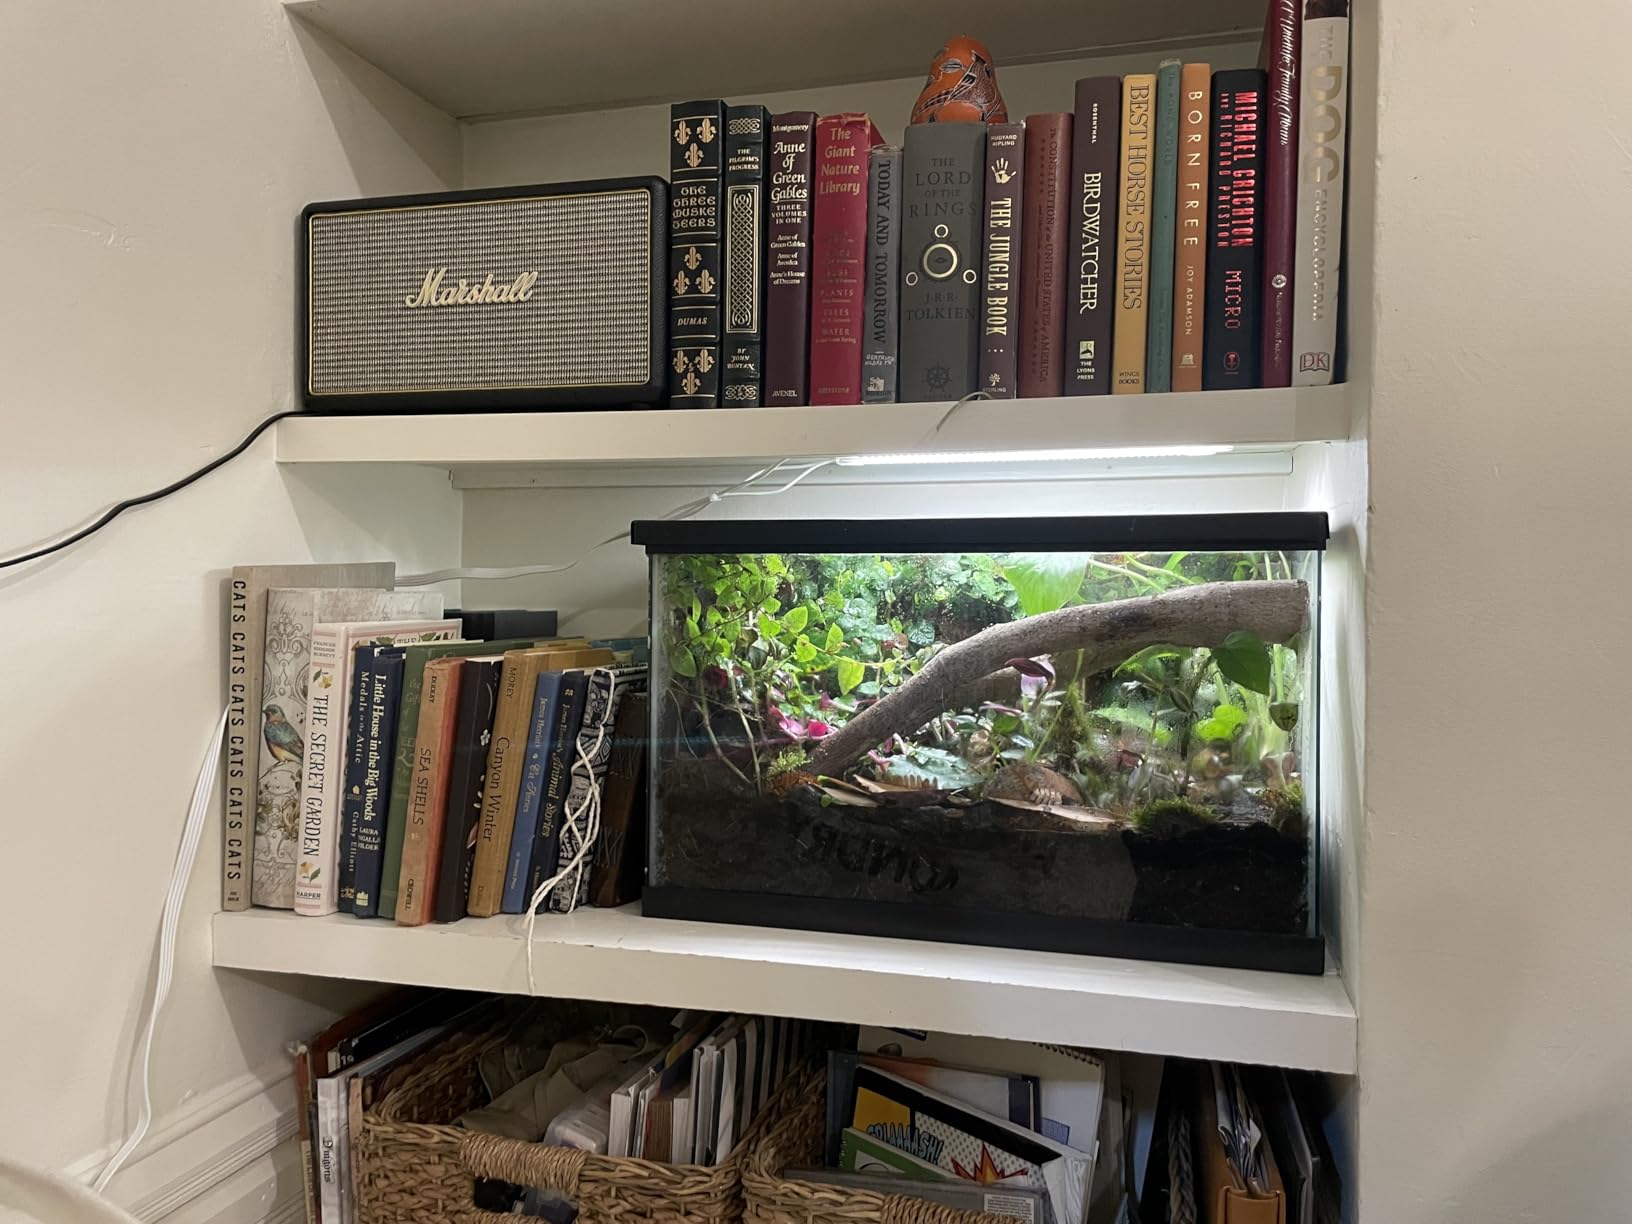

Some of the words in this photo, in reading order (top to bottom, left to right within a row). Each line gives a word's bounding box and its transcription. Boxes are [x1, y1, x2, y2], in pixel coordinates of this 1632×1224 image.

[1279, 15, 1296, 66] Wildlife
[1319, 24, 1334, 63] THE
[1273, 63, 1296, 107] Family
[772, 124, 809, 133] Montgomery
[1128, 85, 1150, 141] BEST
[1187, 91, 1203, 166] BORN
[1233, 91, 1258, 161] MICHAEL
[1277, 105, 1295, 146] Album
[1303, 66, 1343, 184] DOG
[774, 141, 806, 154] Anne
[825, 145, 856, 159] Giant
[830, 128, 851, 140] The
[1218, 114, 1233, 176] RICHARD
[729, 163, 760, 171] PROGRESS
[773, 172, 807, 185] Green
[782, 154, 796, 172] of
[821, 163, 859, 176] Nature
[916, 171, 971, 187] LORD
[931, 158, 955, 168] THE
[1126, 144, 1148, 216] HORSE
[771, 185, 808, 202] Gables
[820, 180, 860, 195] Library
[877, 160, 891, 210] TODAY
[924, 190, 935, 198] OF
[941, 189, 960, 198] THE
[1047, 141, 1058, 225] CONSTITUTION
[672, 207, 715, 219] MUSKE
[771, 210, 807, 218] VOLUMES
[908, 202, 977, 219] RINGS
[990, 197, 1012, 228] THE
[1184, 183, 1200, 246] FREE
[1217, 186, 1231, 247] PRESTON
[1231, 169, 1257, 247] CRICHTON
[792, 233, 798, 241] of
[876, 215, 889, 246] AND
[1079, 172, 1102, 315] BIRDWATCHER
[987, 233, 1011, 291] JUNGLE
[1043, 244, 1054, 287] UNITED
[1122, 220, 1146, 310] STORIES
[1312, 189, 1328, 321] ENCYCLOPEDIA
[405, 267, 539, 308] Marshall
[1186, 265, 1194, 283] JOY
[873, 252, 888, 344] TOMORROW
[906, 308, 976, 321] TOLKIEN
[1042, 288, 1052, 326] STATES
[1184, 287, 1194, 336] ADAMSON
[1224, 270, 1242, 329] MICRO
[677, 317, 708, 326] DUMAS
[986, 297, 1008, 336] BOOK
[1039, 334, 1050, 383] AMERICA
[1303, 354, 1327, 368] DK
[233, 581, 246, 623] CATS
[232, 632, 246, 674] CATS
[359, 671, 370, 712] Medals
[373, 674, 387, 704] Little
[507, 667, 517, 698] MOREY
[231, 684, 245, 726] CATS
[312, 695, 329, 727] THE
[370, 705, 385, 738] House
[539, 697, 549, 718] James
[230, 736, 244, 778] CATS
[307, 732, 328, 794] SECRET
[355, 734, 365, 764] Attic
[368, 753, 380, 768] the
[369, 740, 382, 754] in
[418, 748, 431, 772] SEA
[490, 737, 510, 789] Canyon
[364, 768, 379, 788] Big
[547, 752, 565, 798] Animal
[229, 787, 243, 829] CATS
[363, 787, 378, 821] Woods
[412, 777, 428, 826] SHELLS
[522, 782, 537, 813] Stories
[303, 797, 324, 857] GARDEN
[350, 811, 360, 839] Cathy
[359, 827, 379, 836] LAURA
[483, 795, 502, 842] Winter
[541, 803, 557, 838] Stories
[227, 839, 242, 880] CATS
[348, 841, 358, 872] Elliott
[296, 891, 321, 899] HARPER
